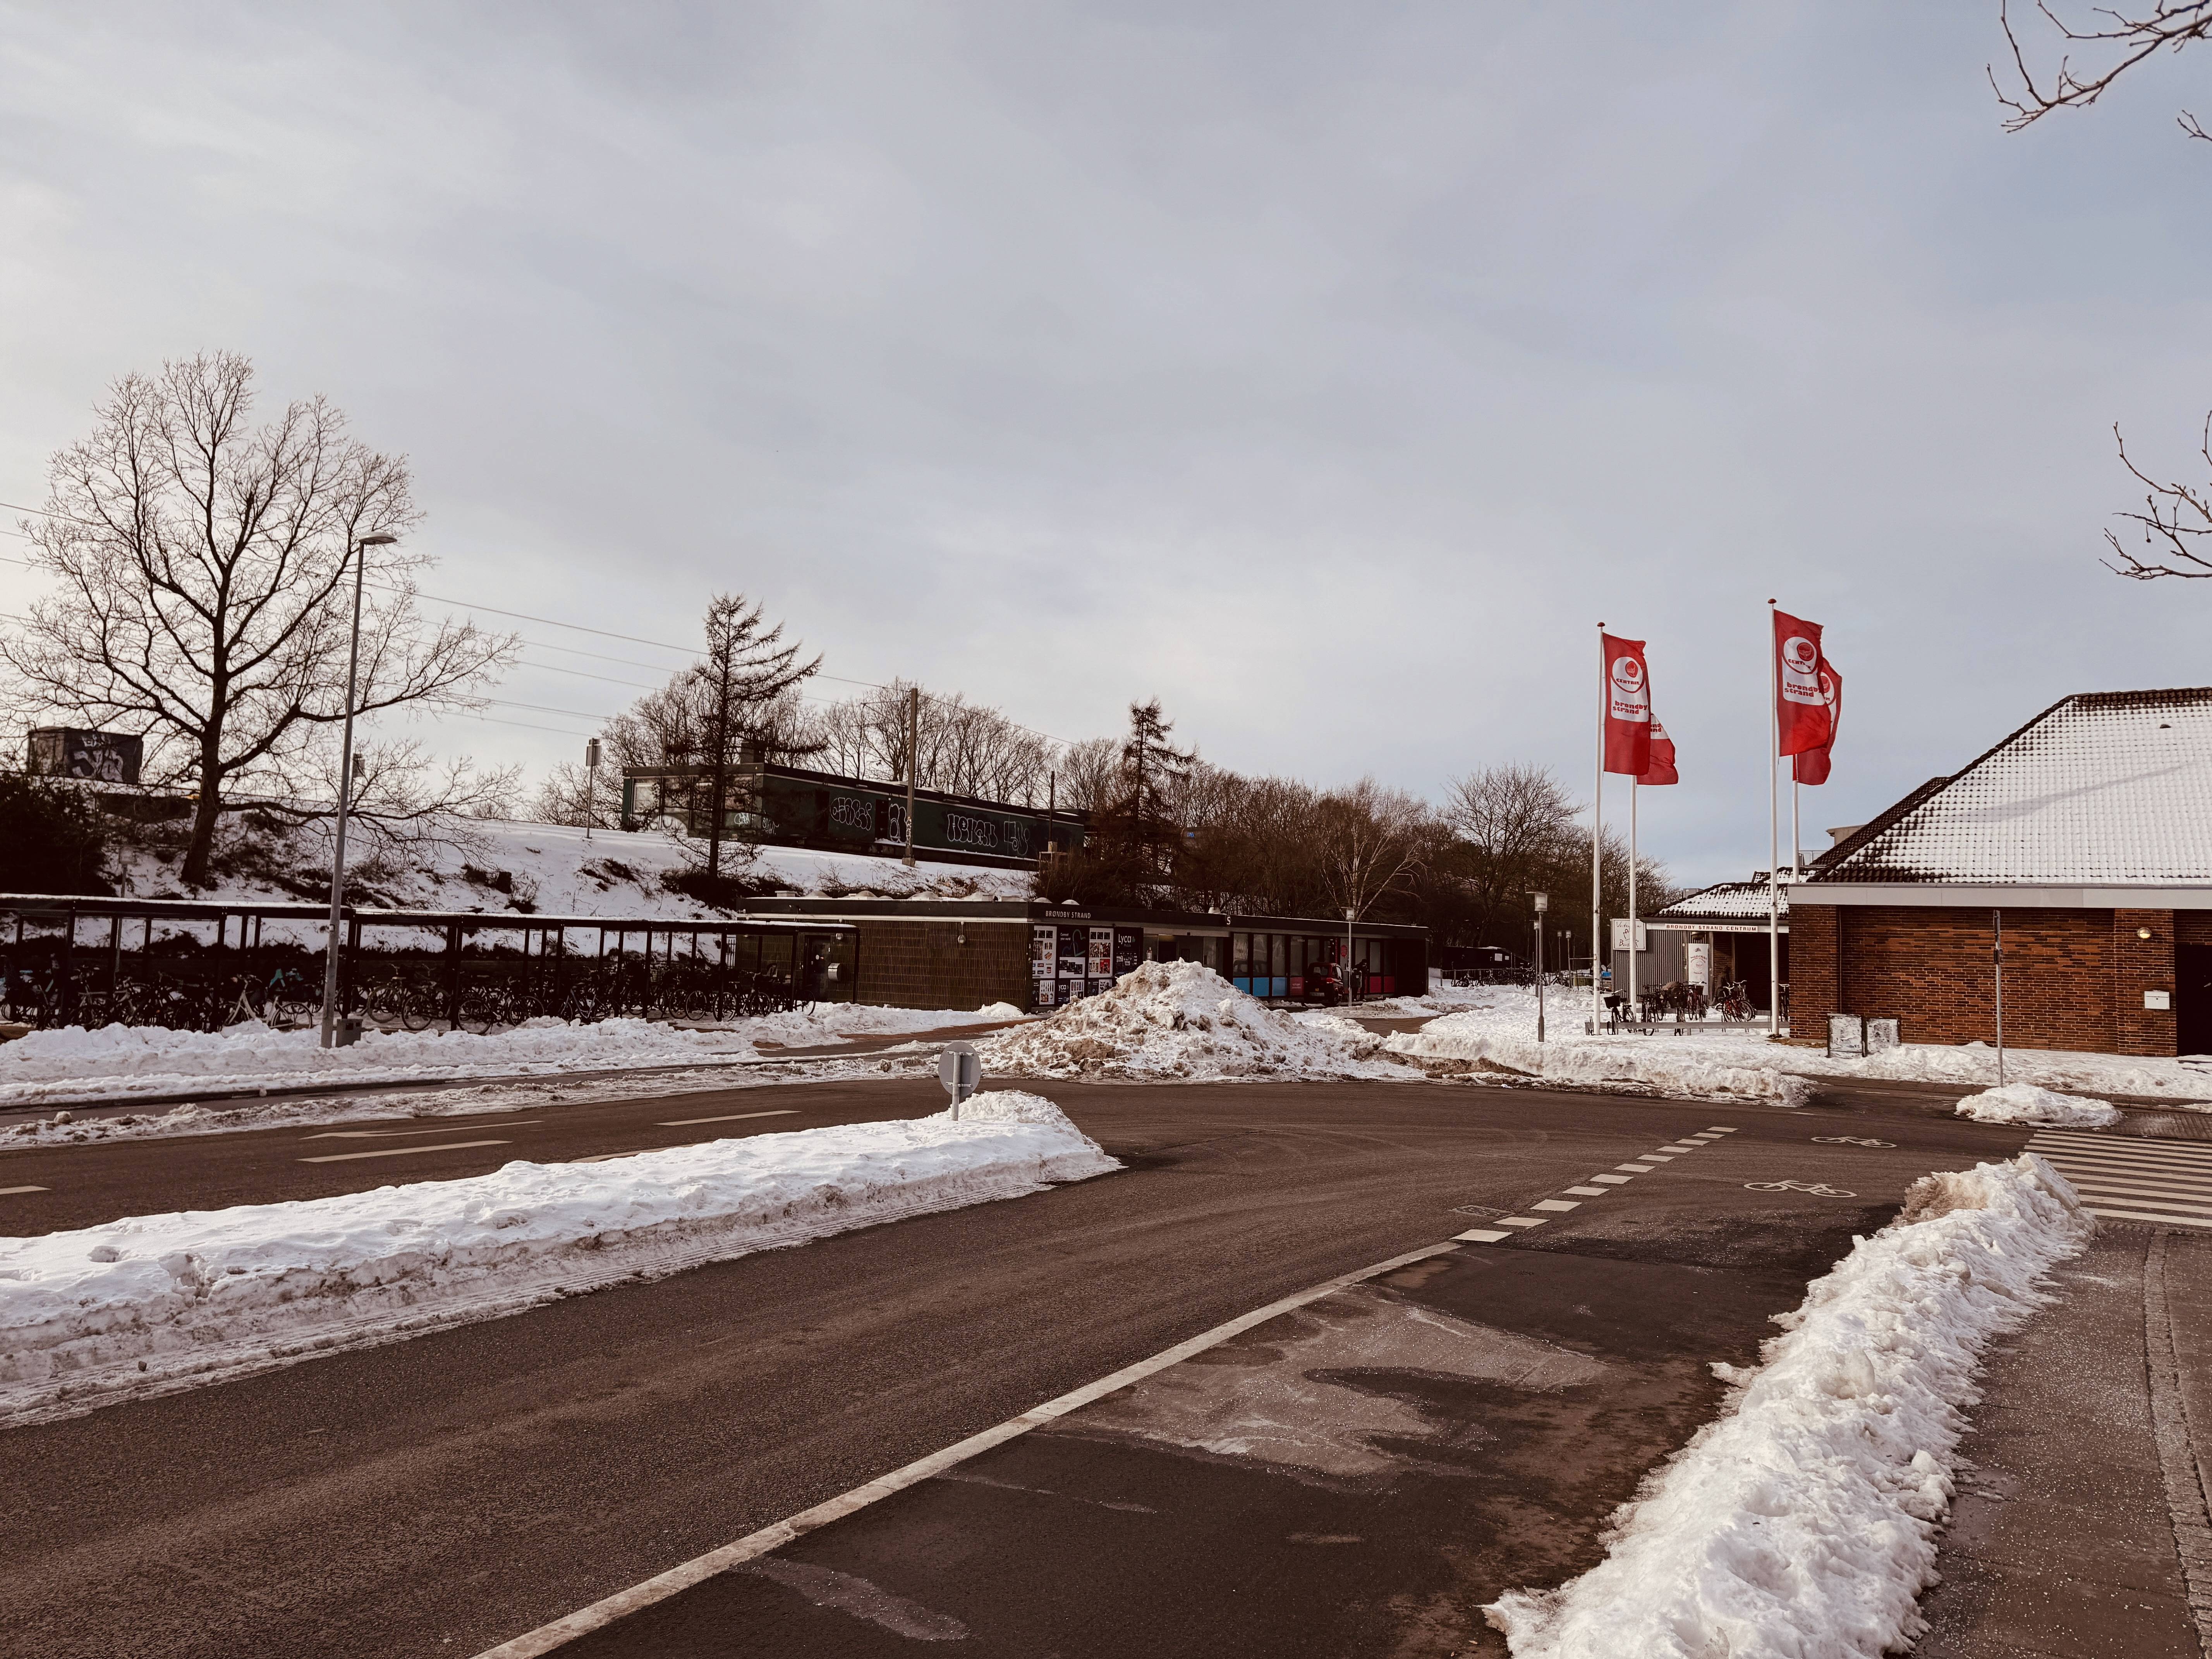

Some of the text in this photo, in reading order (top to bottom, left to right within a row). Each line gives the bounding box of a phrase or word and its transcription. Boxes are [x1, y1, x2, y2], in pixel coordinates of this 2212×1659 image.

[1784, 688, 1814, 697] strand
[1613, 706, 1639, 714] strand
[1118, 933, 1131, 945] Lyca
